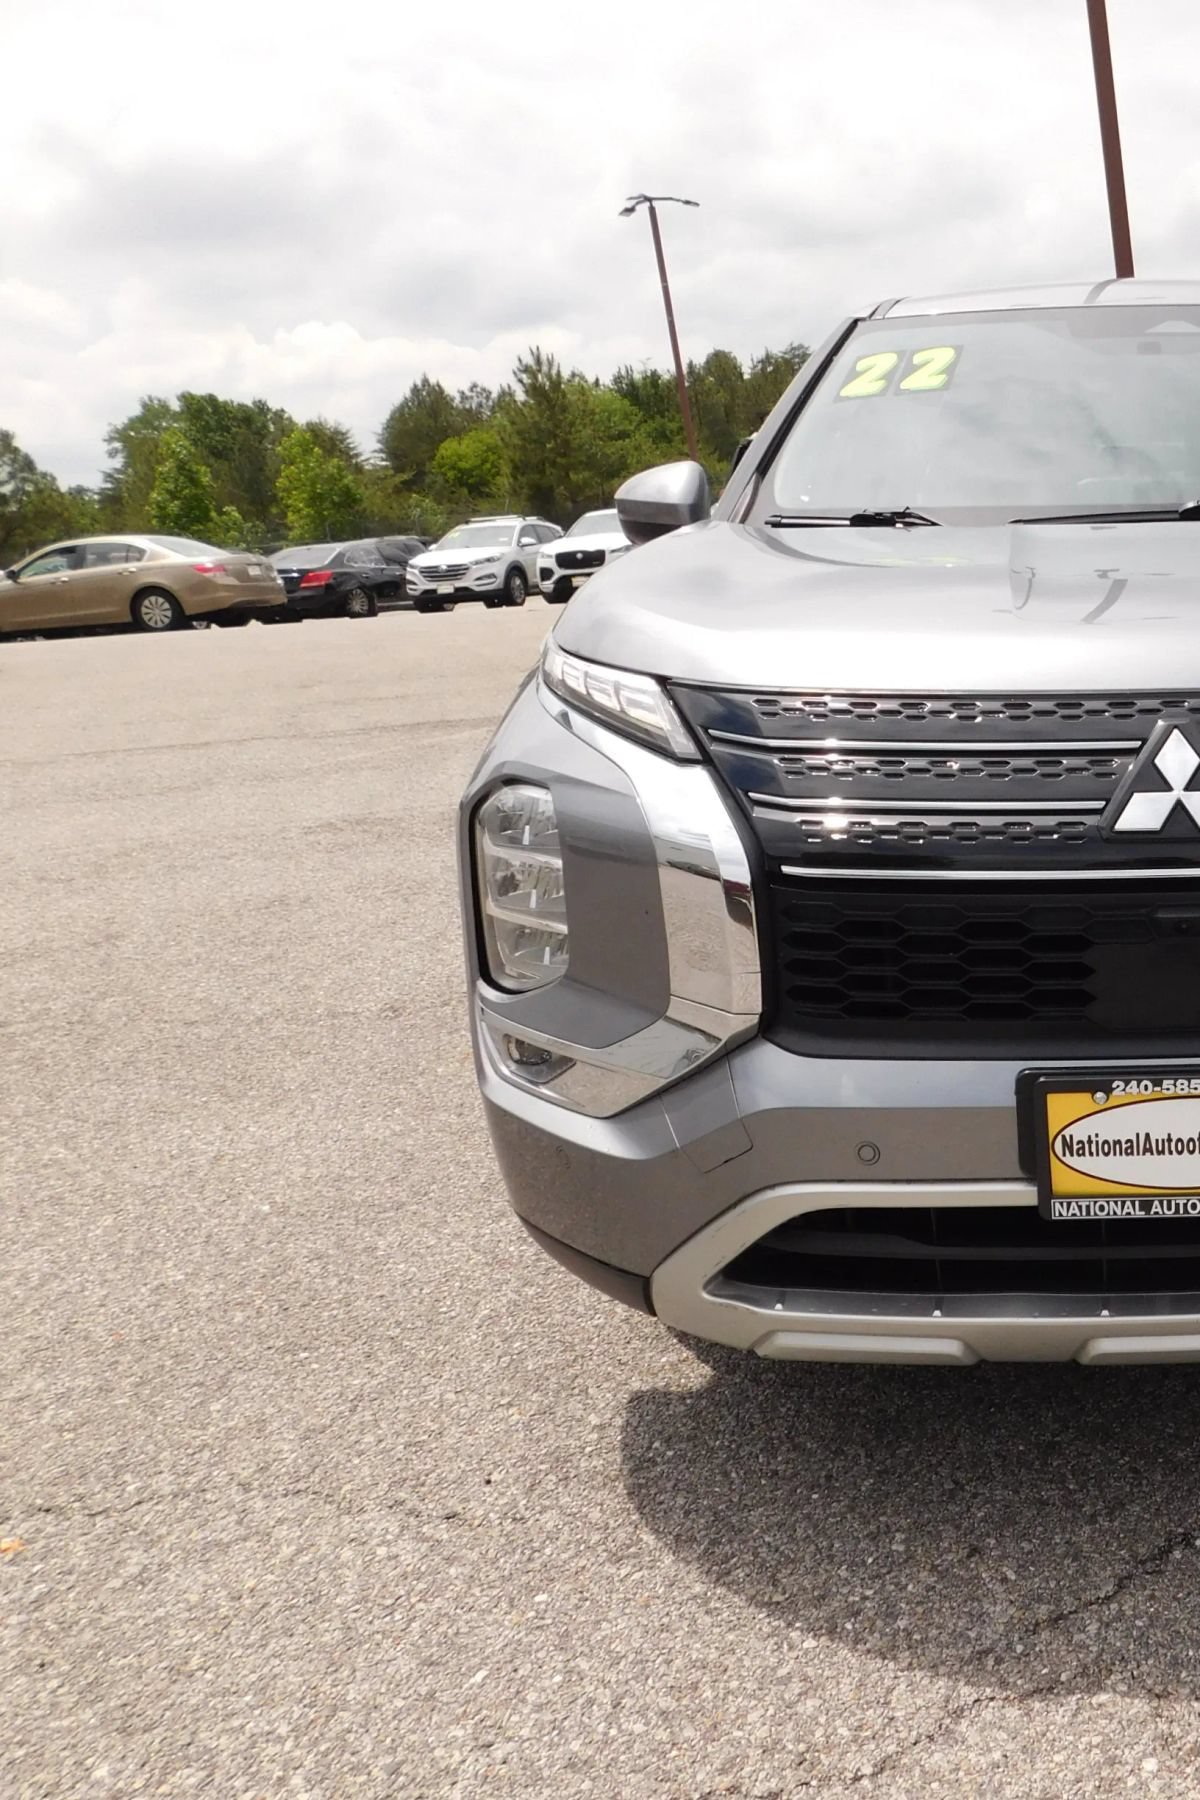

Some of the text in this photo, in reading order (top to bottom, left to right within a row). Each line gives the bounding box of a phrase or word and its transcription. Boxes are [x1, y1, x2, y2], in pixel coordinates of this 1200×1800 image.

[840, 347, 956, 397] 22
[1054, 1201, 1145, 1217] NATIONAL
[1151, 1200, 1200, 1215] AUTO
